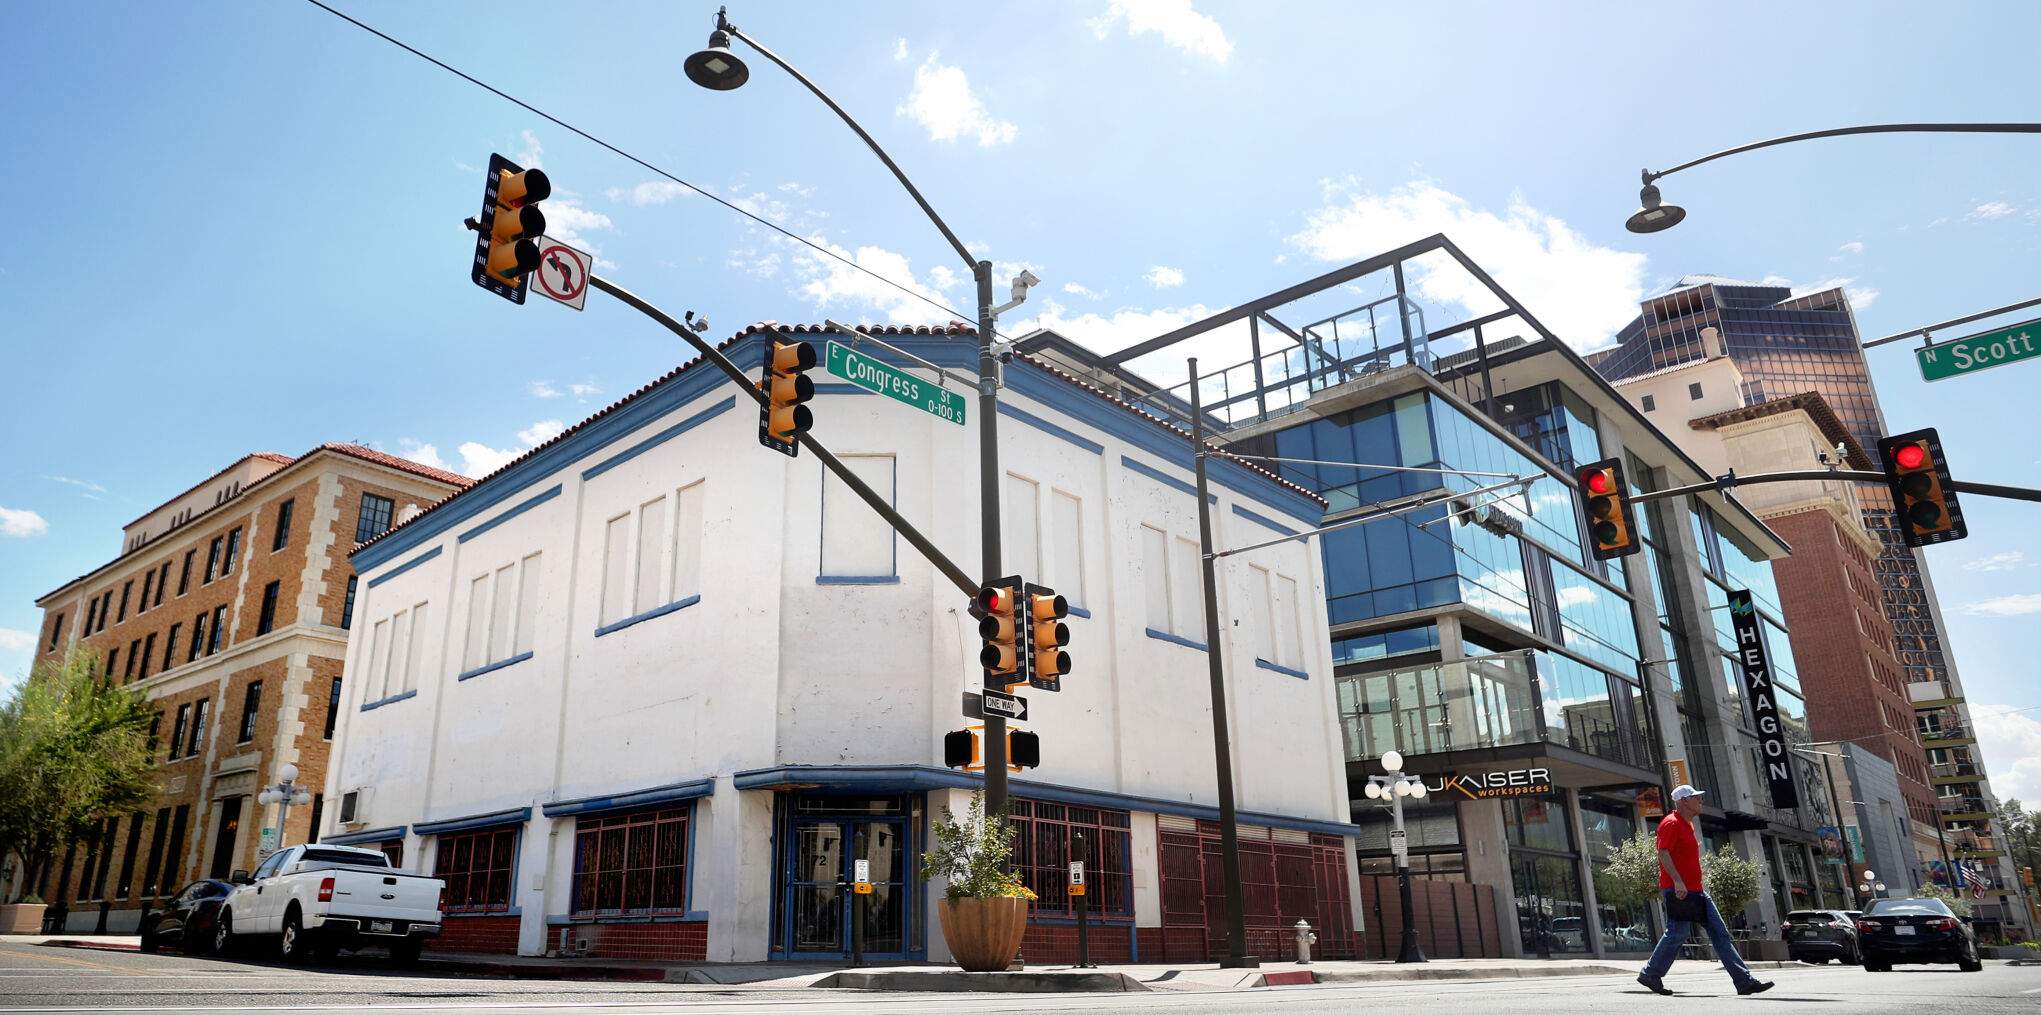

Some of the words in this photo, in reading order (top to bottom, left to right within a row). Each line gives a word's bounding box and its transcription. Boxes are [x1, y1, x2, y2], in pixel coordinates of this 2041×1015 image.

[1924, 349, 1938, 363] N
[1951, 332, 2035, 369] Scott
[832, 344, 838, 359] E
[846, 354, 919, 401] Congress
[940, 390, 951, 404] St
[928, 399, 953, 420] 0-100
[956, 410, 962, 424] S
[987, 697, 1000, 709] ONE
[1001, 700, 1015, 711] WAY
[1739, 626, 1788, 781] HEXAGON
[1426, 768, 1550, 800] JKAISER
[1477, 784, 1550, 798] workspaces
